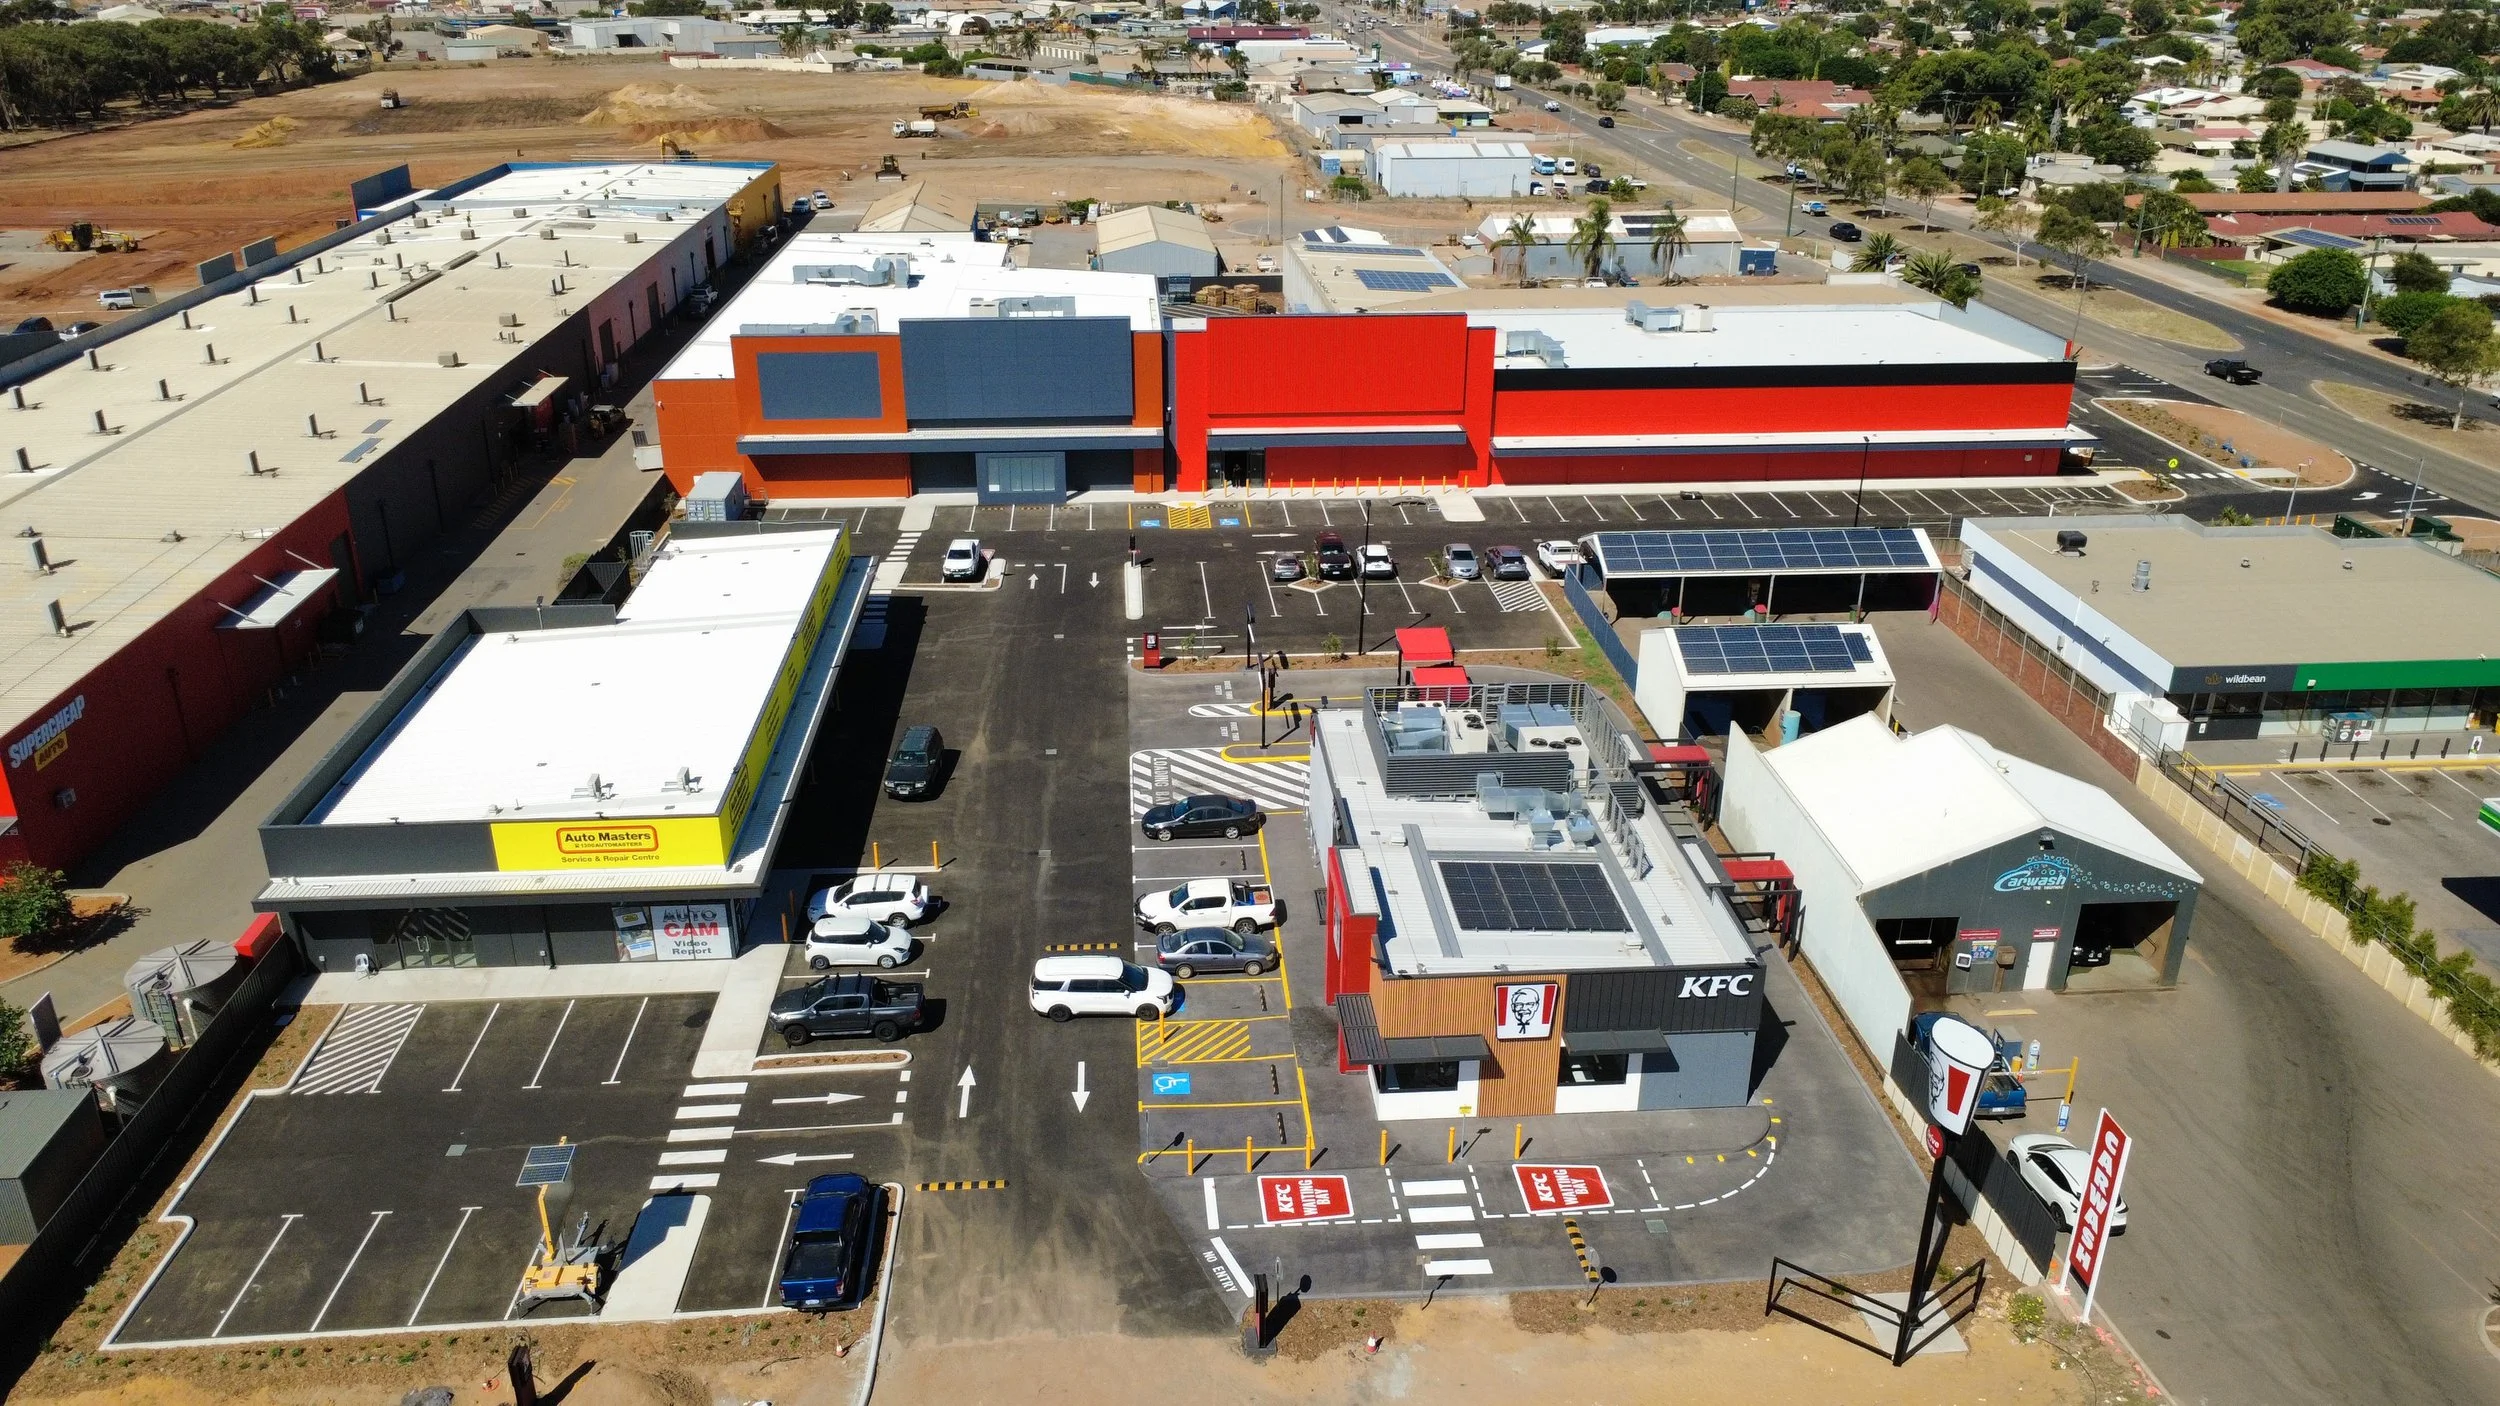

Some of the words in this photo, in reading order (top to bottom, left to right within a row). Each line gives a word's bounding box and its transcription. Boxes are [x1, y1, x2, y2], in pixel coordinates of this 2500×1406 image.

[2225, 675, 2266, 683] wildbean
[8, 694, 85, 769] SUPERCHEAP
[37, 739, 66, 766] AUTO
[1153, 757, 1169, 787] LOADING
[565, 833, 595, 842] Auto
[598, 832, 651, 841] Masters
[662, 908, 717, 922] AUTO
[663, 922, 719, 937] CAM
[672, 947, 712, 956] Report
[1678, 974, 1754, 998] KFC
[1275, 1184, 1295, 1213] KFC
[1298, 1179, 1318, 1216] WAITING
[1314, 1188, 1331, 1205] BAY
[1530, 1173, 1556, 1203] KFC
[1553, 1169, 1579, 1205] WAITING
[1570, 1178, 1589, 1195] BAY
[2075, 1130, 2119, 1272] CARWASH
[1202, 1250, 1218, 1263] NO
[1212, 1265, 1239, 1293] ENTRY
